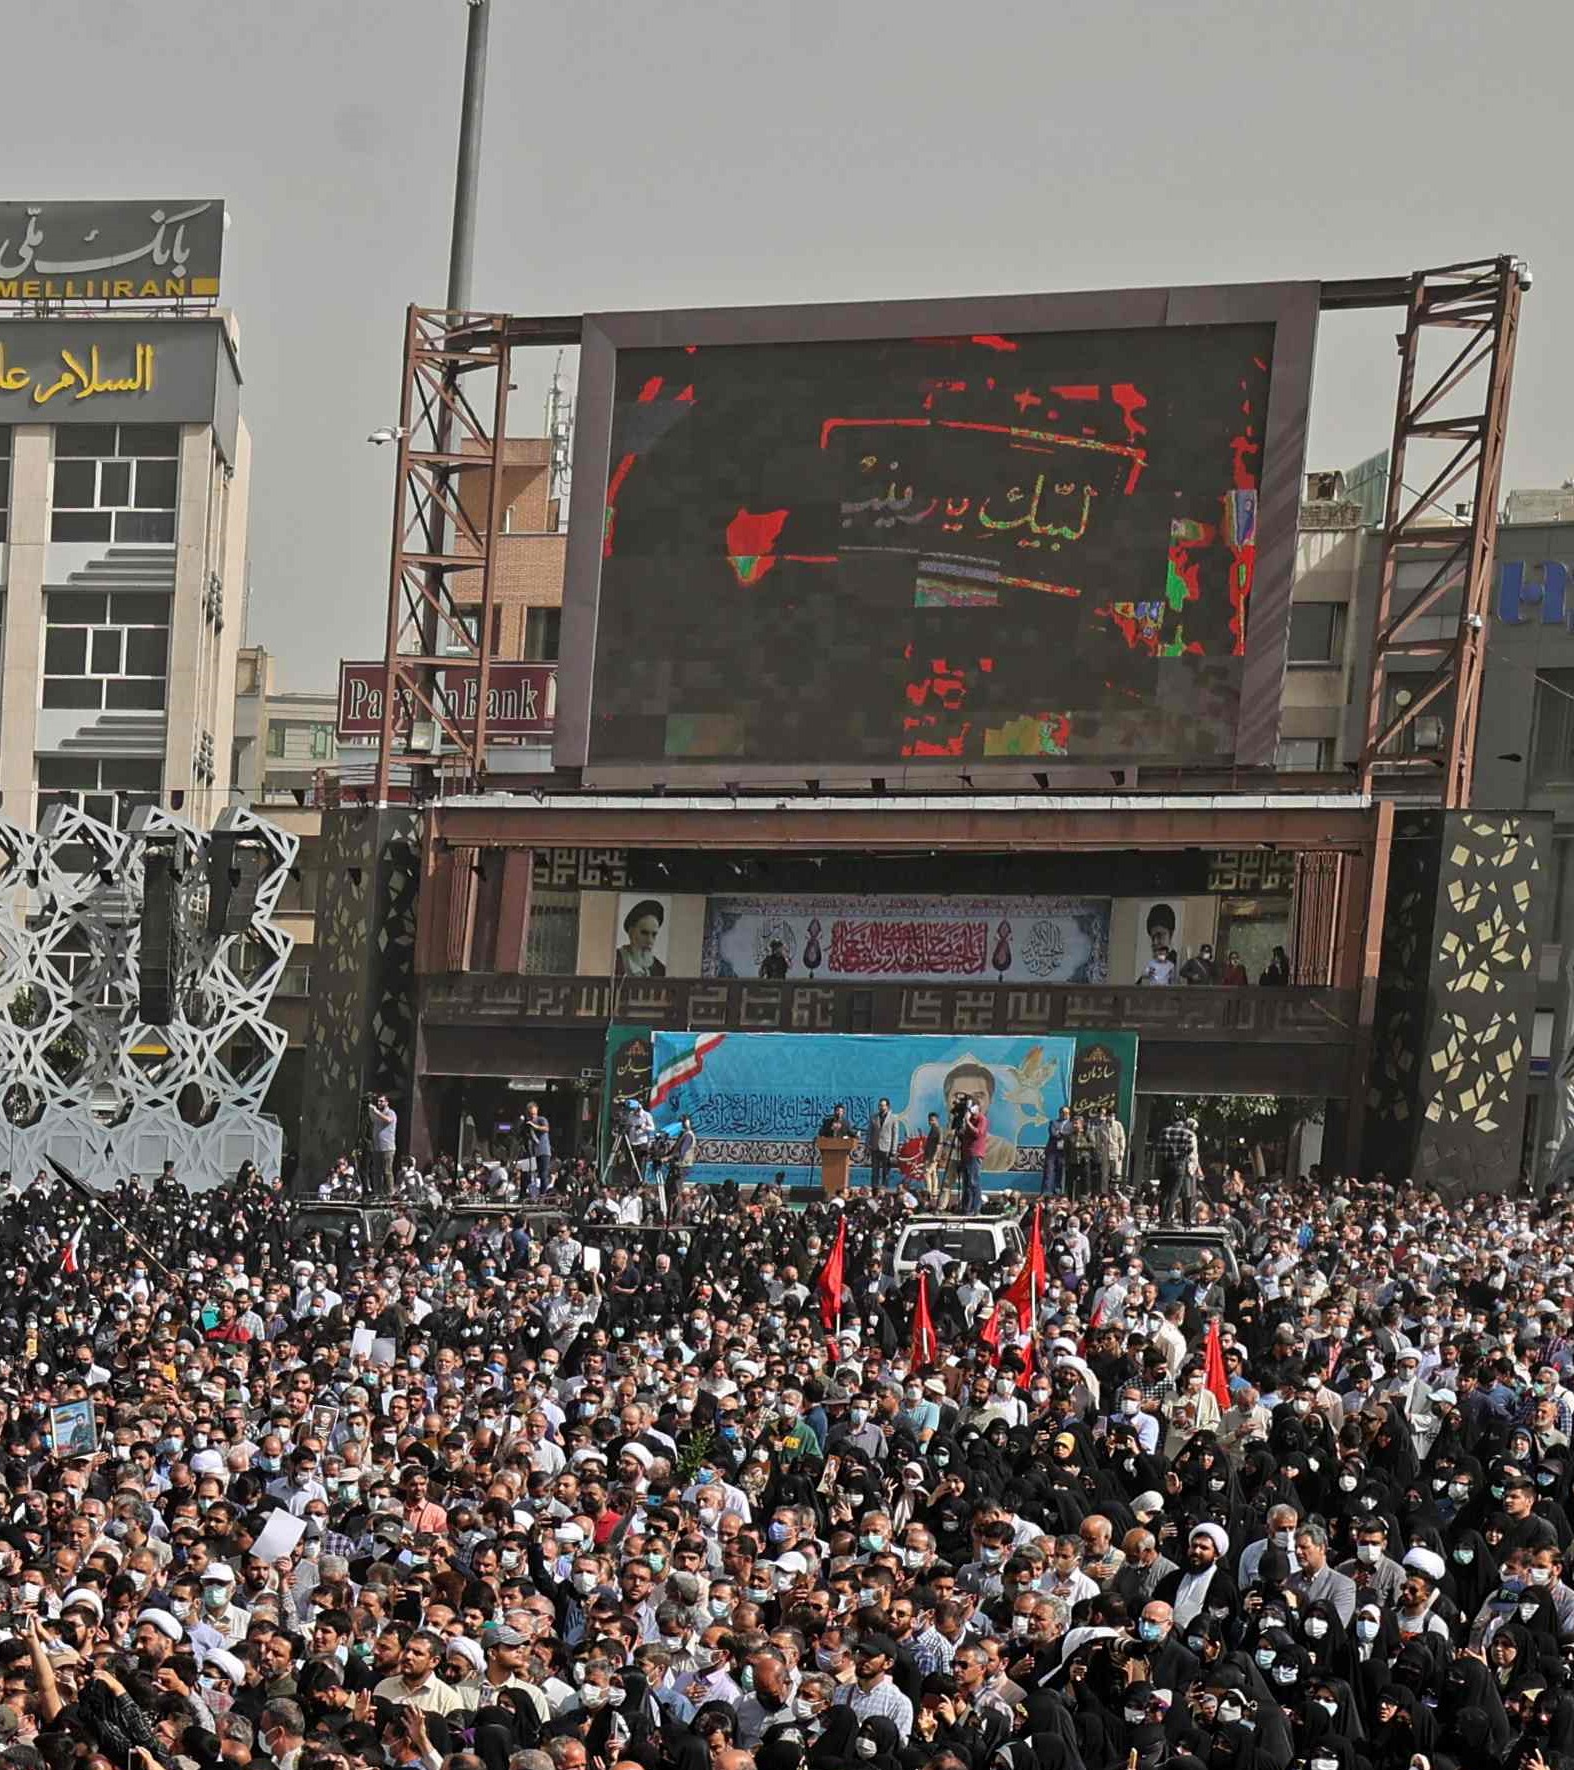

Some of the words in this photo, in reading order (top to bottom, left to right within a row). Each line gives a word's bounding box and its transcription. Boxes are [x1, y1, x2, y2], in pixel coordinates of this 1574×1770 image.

[102, 278, 186, 297] IRAN
[34, 342, 154, 403] السلام
[464, 678, 538, 720] Bank
